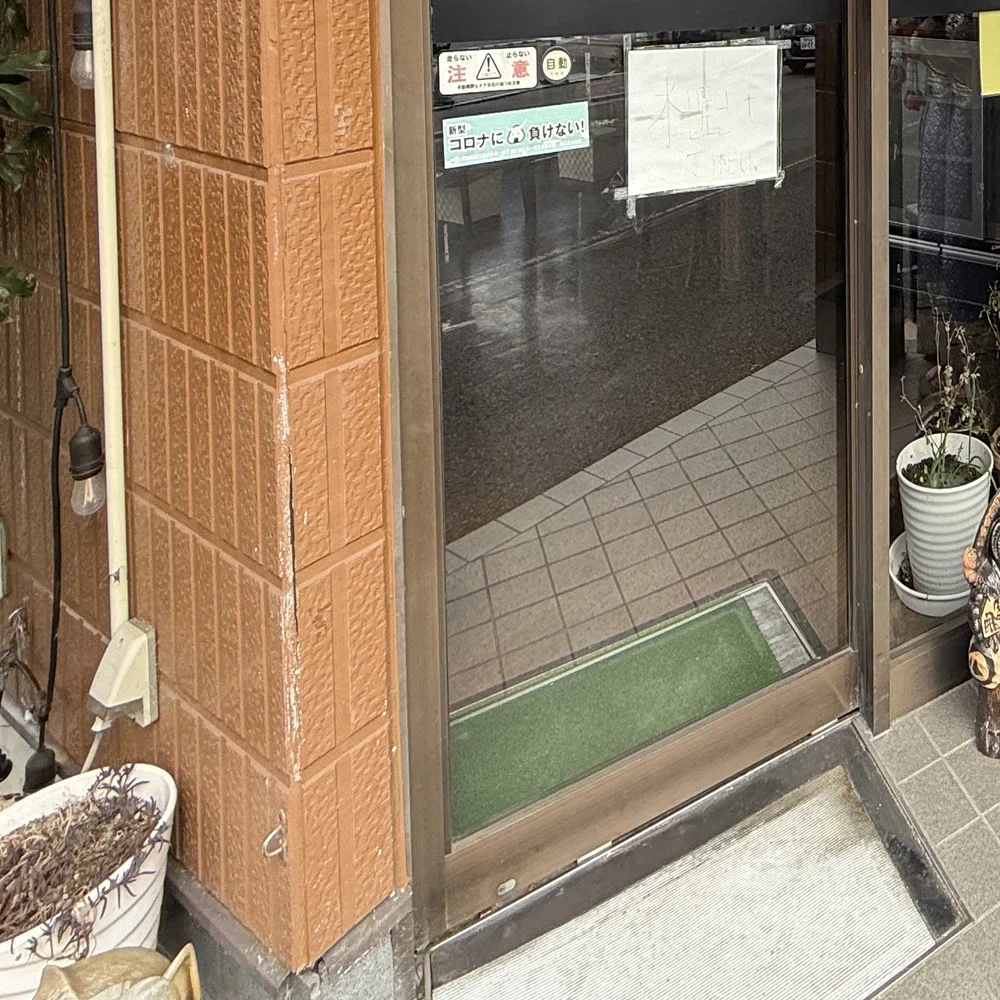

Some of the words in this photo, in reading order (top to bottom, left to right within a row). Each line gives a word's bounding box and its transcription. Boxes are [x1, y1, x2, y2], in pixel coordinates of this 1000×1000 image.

[447, 64, 467, 83] 注
[511, 60, 530, 78] 意
[546, 57, 568, 71] 自動
[449, 132, 504, 151] コロナに
